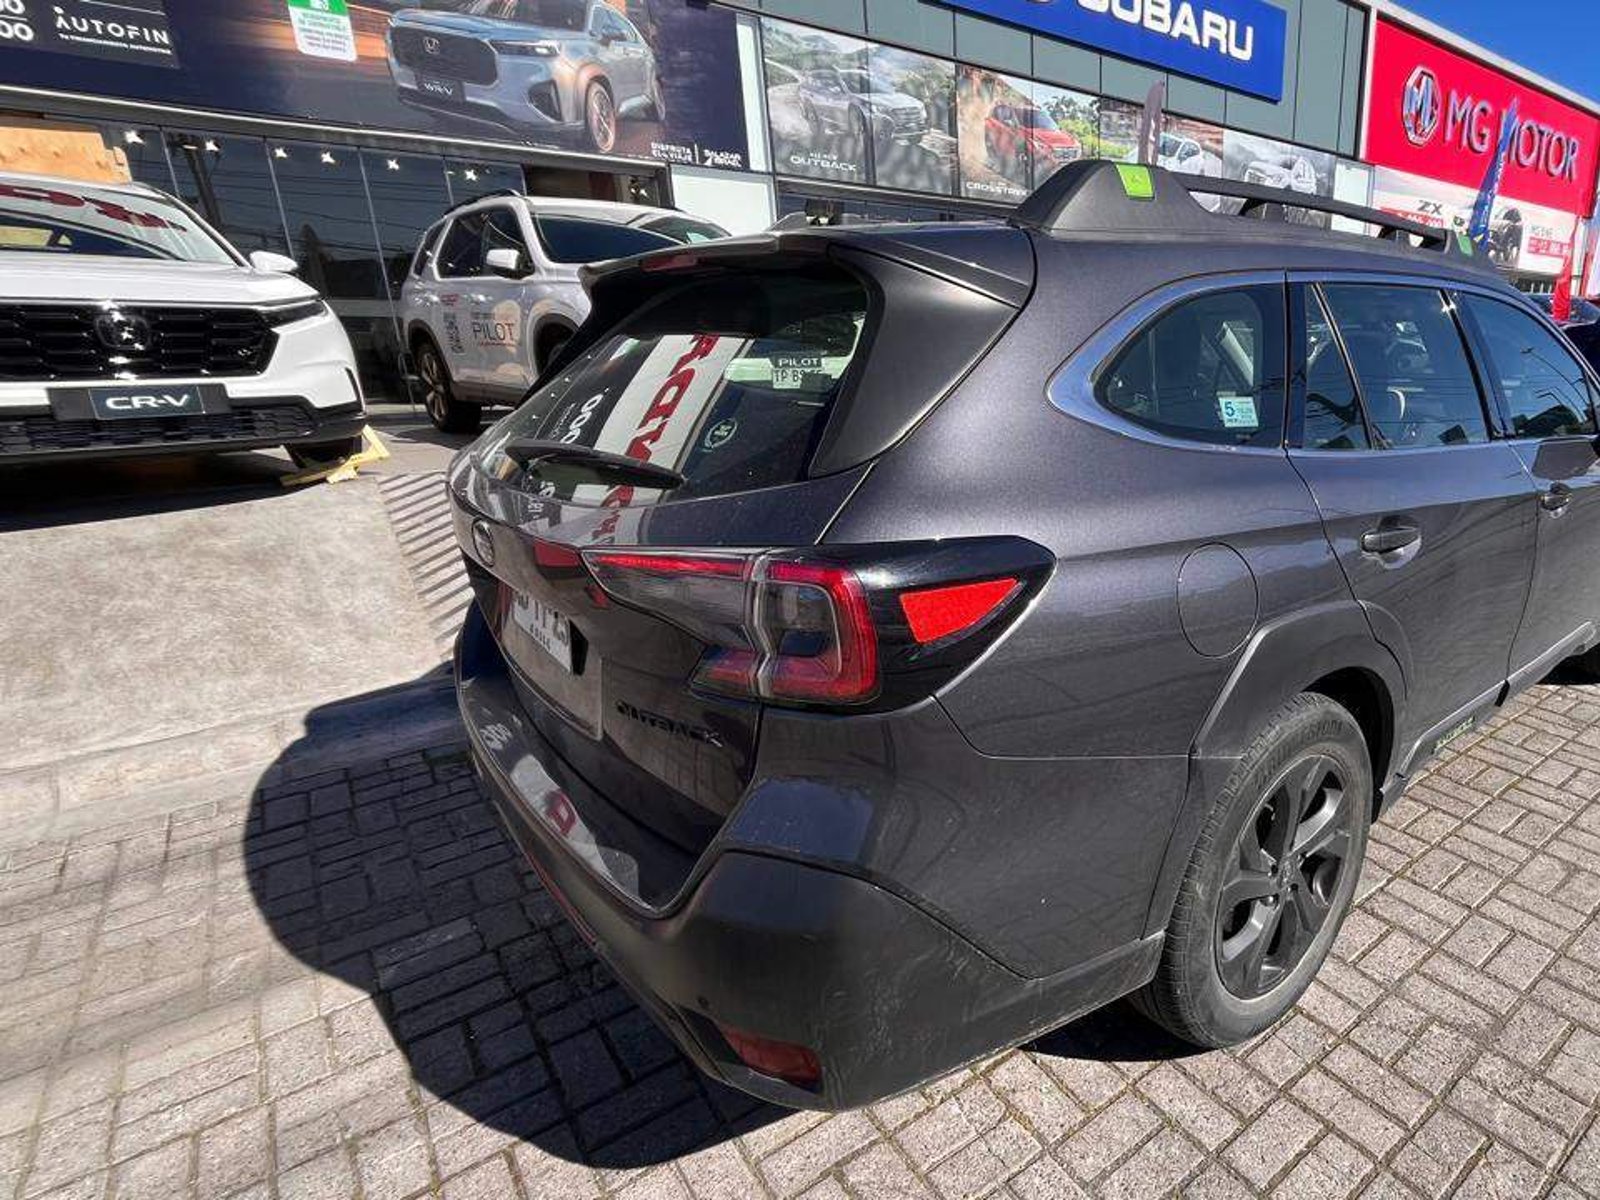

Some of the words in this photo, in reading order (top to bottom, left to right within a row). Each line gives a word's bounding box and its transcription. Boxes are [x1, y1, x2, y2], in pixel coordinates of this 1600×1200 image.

[53, 6, 170, 44] AUTOFIN
[1444, 88, 1491, 152] MG
[790, 154, 857, 171] OUTBACK
[1418, 200, 1442, 214] ZX
[472, 322, 514, 341] PILOT
[779, 357, 819, 368] PILOT
[105, 393, 189, 410] CR-V
